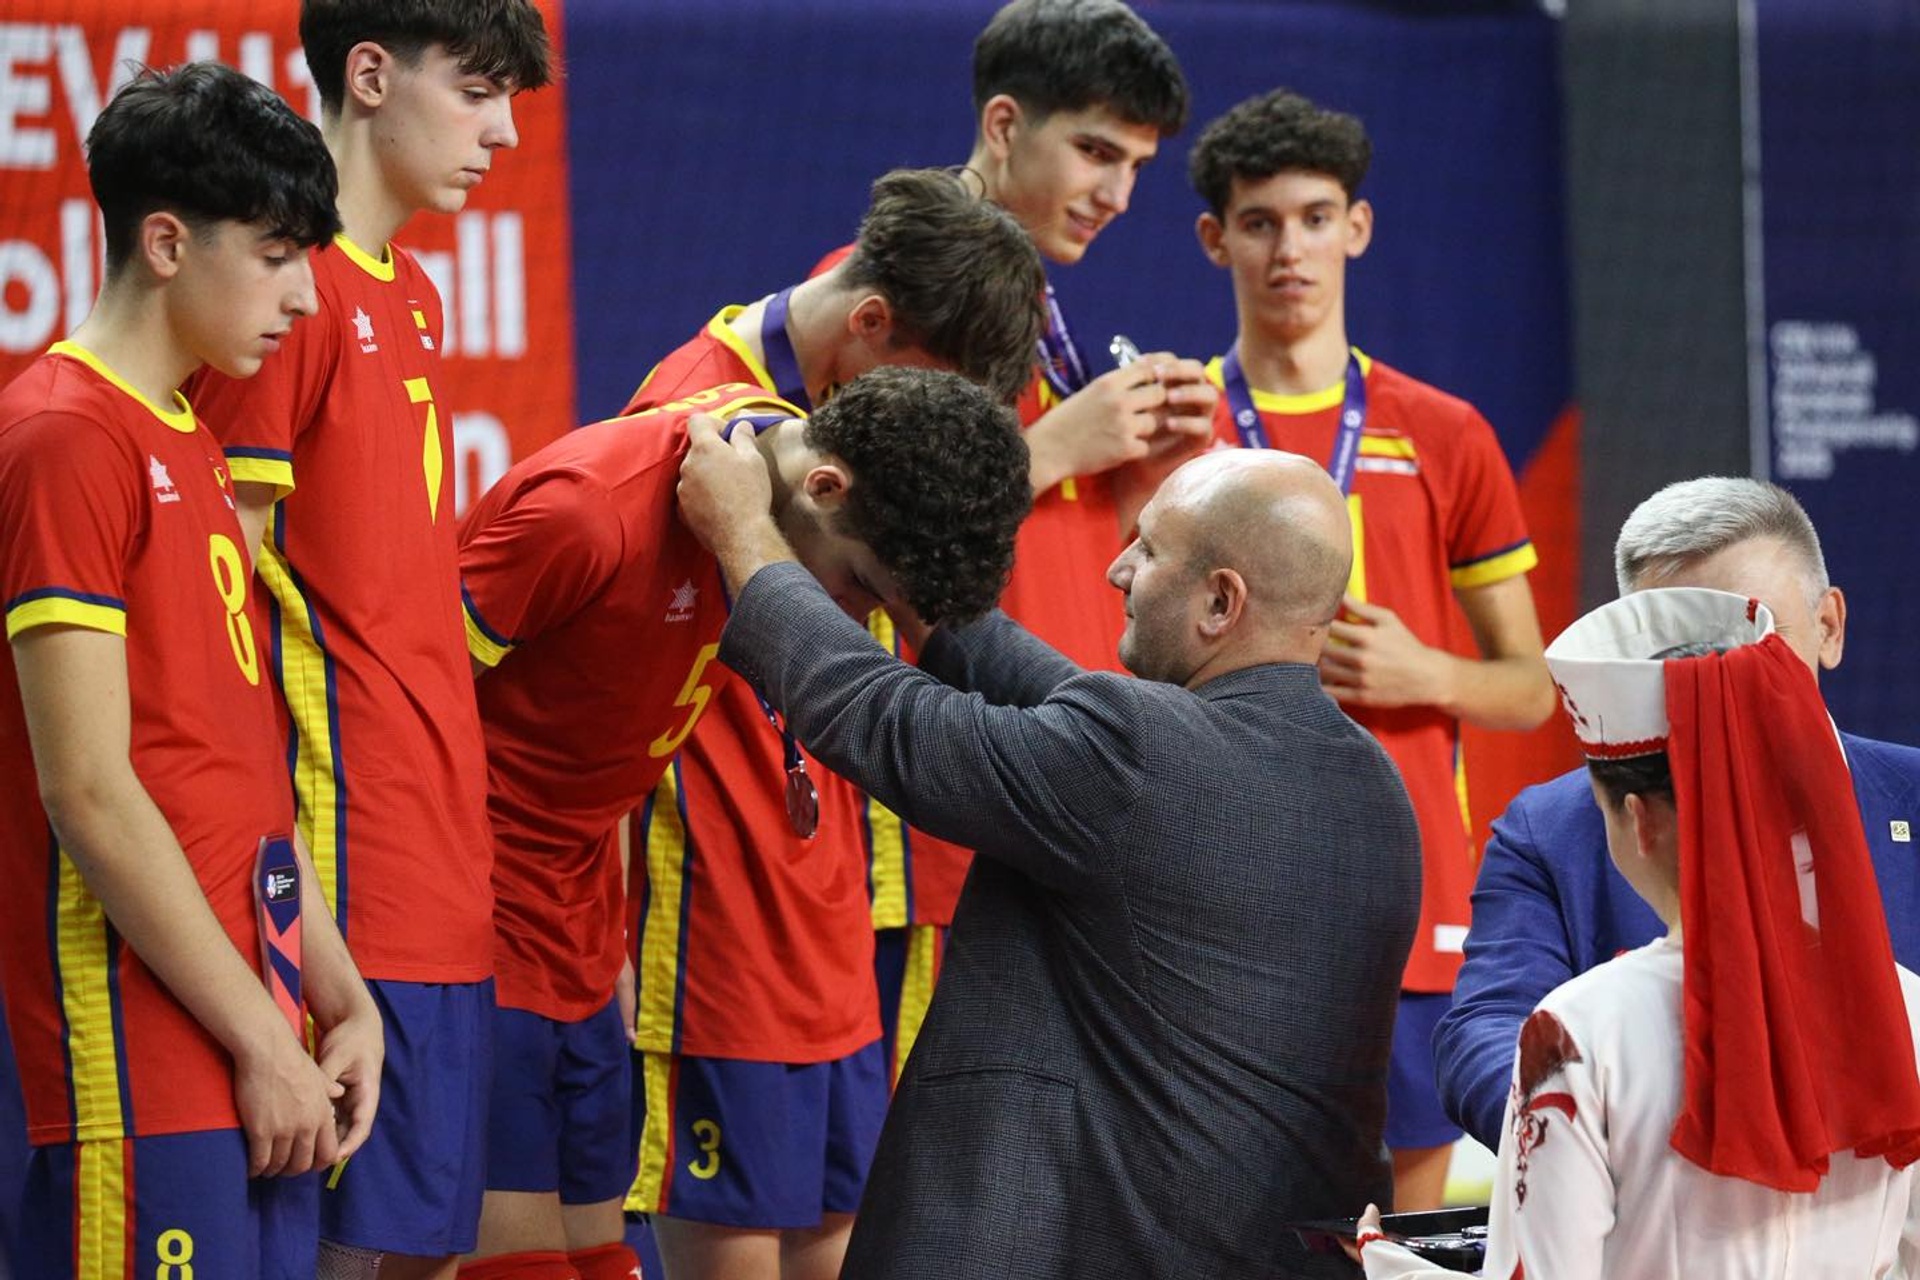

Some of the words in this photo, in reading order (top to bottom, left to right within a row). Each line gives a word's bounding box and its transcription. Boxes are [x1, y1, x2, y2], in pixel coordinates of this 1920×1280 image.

[402, 376, 443, 526] 7
[209, 534, 259, 686] 8
[648, 643, 719, 758] 5
[688, 1118, 719, 1179] 3
[156, 1228, 194, 1280] 8
